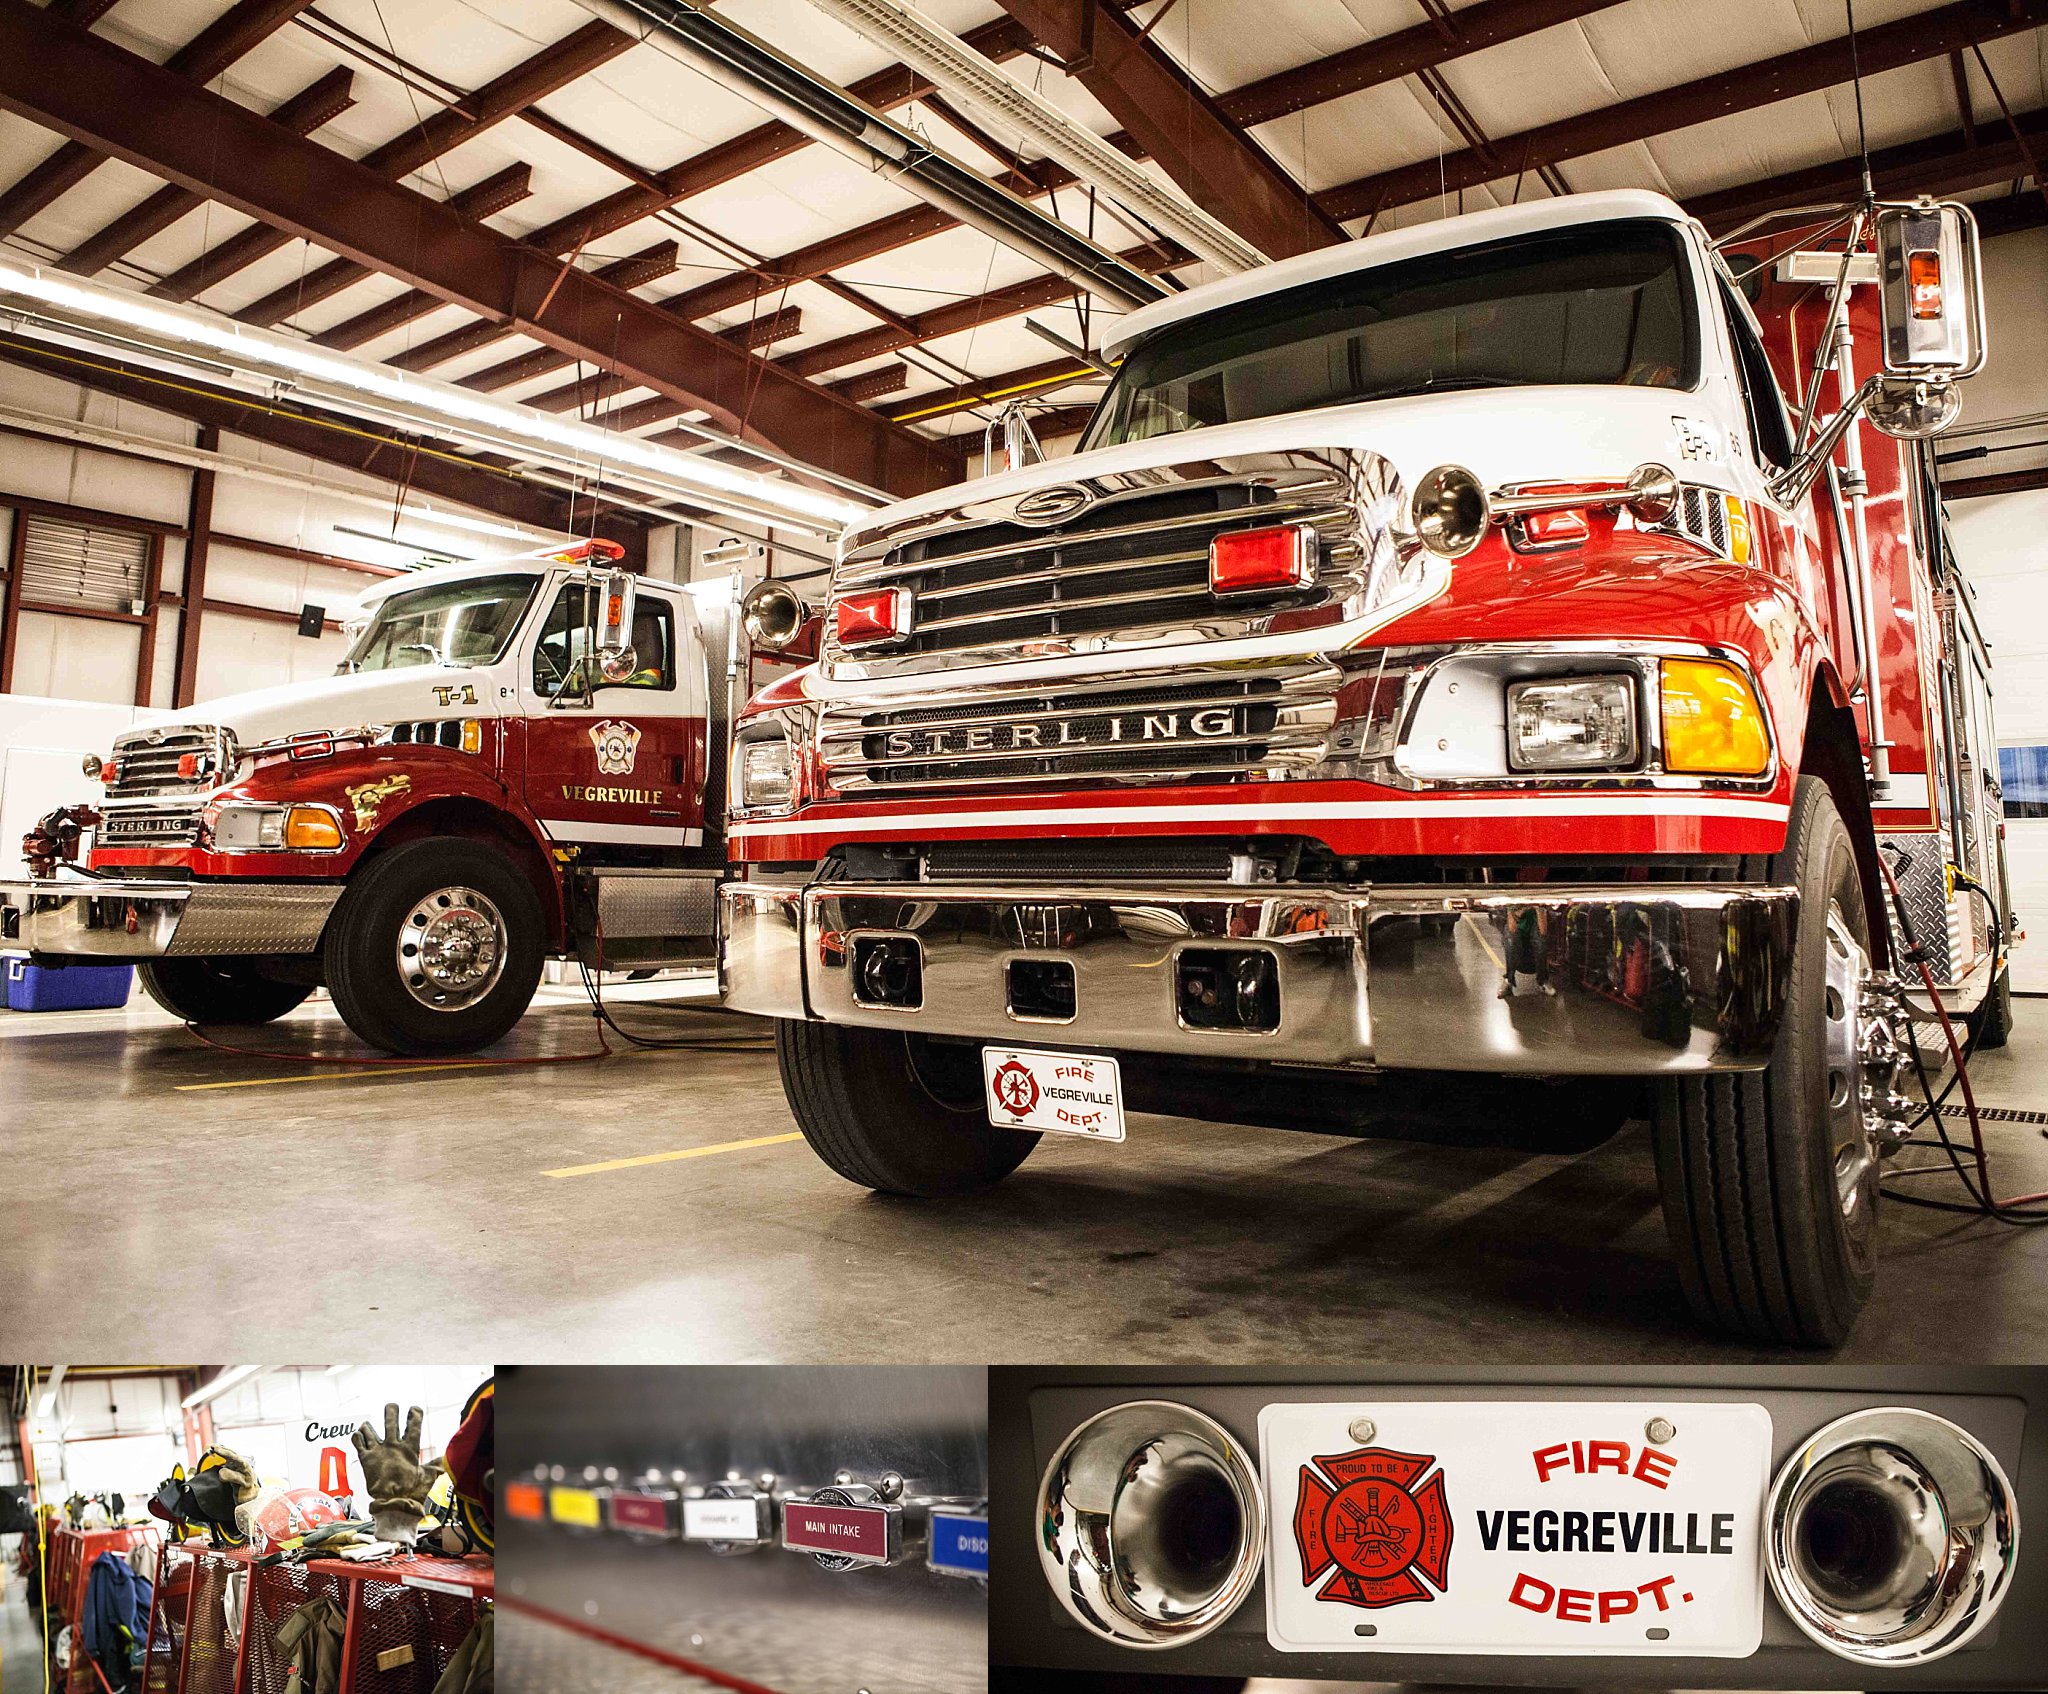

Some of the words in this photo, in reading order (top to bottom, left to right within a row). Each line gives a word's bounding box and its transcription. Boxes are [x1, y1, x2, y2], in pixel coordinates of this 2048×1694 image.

[432, 684, 479, 706] T-1
[887, 708, 1234, 756] STERLING
[561, 785, 662, 805] VEGREVILLE
[111, 819, 182, 832] STERLING
[1055, 1066, 1095, 1083] FIRE
[1042, 1086, 1113, 1105] VEGREVILLE
[1056, 1108, 1108, 1126] DEPT.
[305, 1422, 355, 1442] Crew
[1336, 1464, 1366, 1473] PROUD
[1371, 1464, 1382, 1473] TO
[1387, 1464, 1398, 1473] BE
[1403, 1464, 1409, 1473] A
[1532, 1440, 1678, 1490] FIRE
[805, 1520, 826, 1534] MAIN
[829, 1523, 861, 1538] INTAKE
[1309, 1509, 1317, 1550] FIRE
[1428, 1494, 1437, 1564] FIGHTER
[1476, 1509, 1735, 1554] VEGREVILLE
[1508, 1572, 1694, 1623] DEPT.
